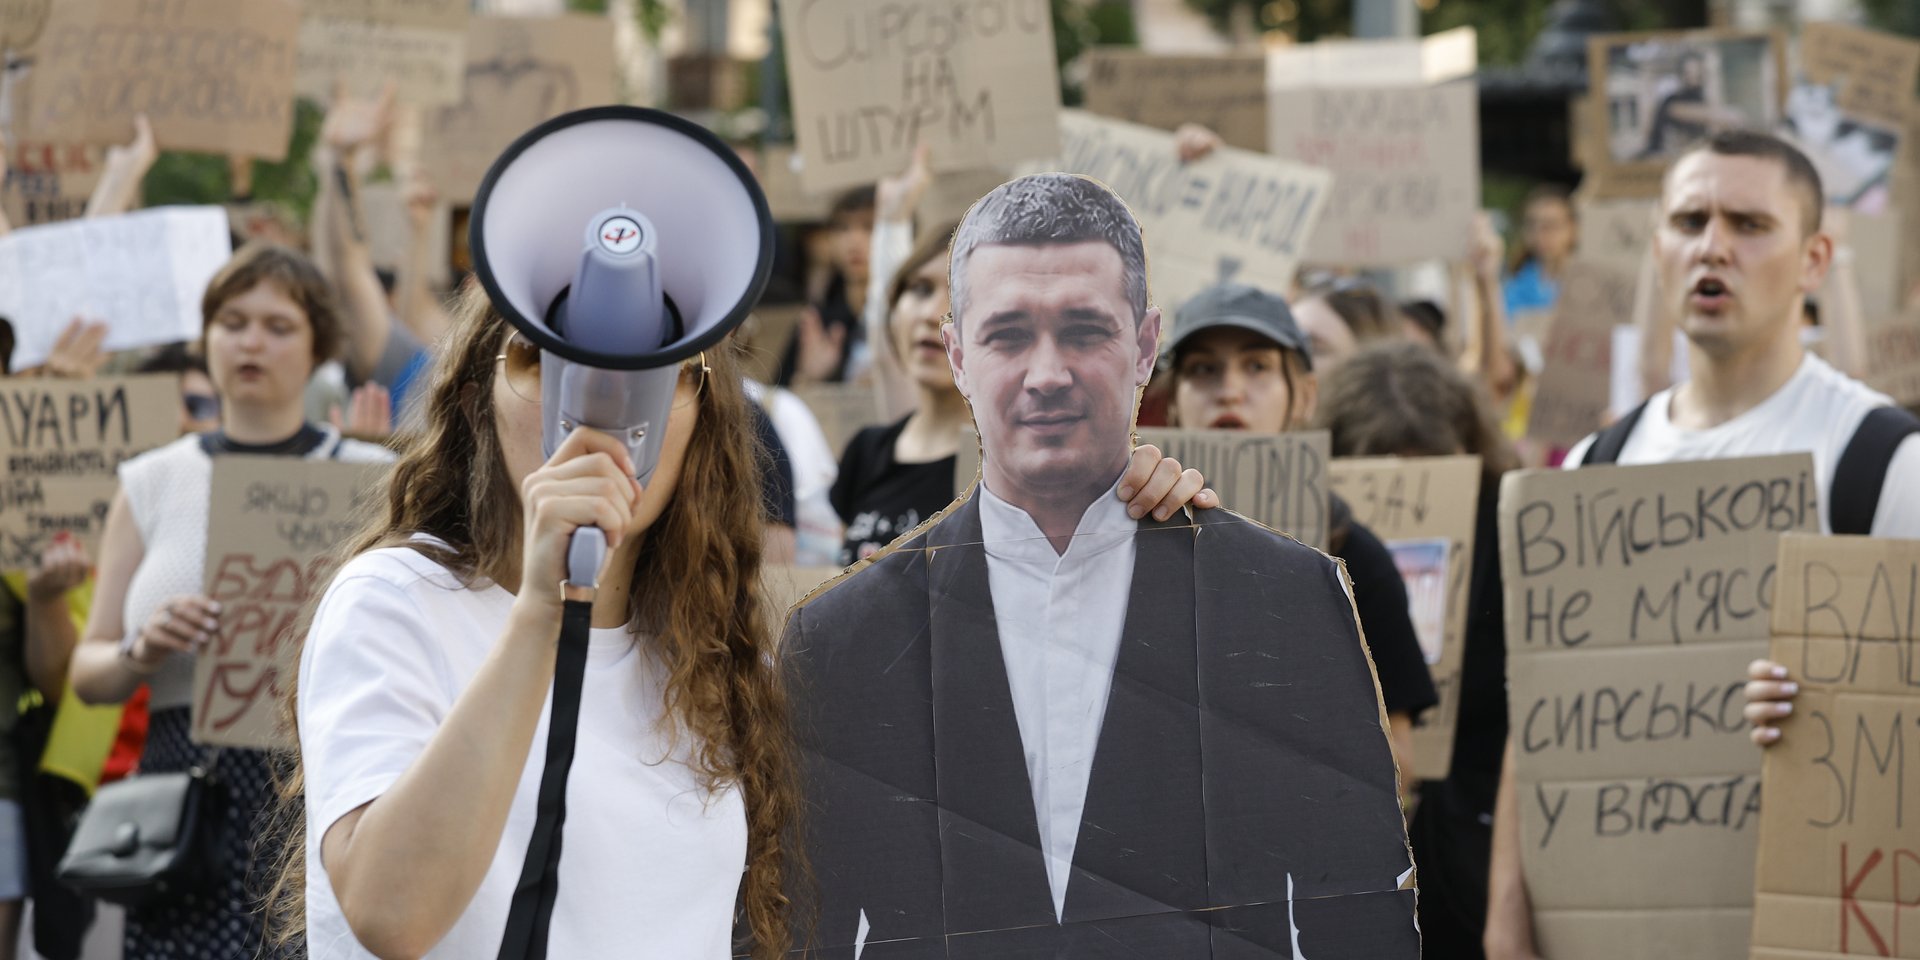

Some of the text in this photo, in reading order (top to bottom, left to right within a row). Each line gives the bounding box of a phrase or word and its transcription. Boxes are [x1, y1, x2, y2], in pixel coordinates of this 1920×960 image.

[901, 54, 959, 103] НА
[815, 86, 998, 163] ШТУРМ
[1808, 711, 1920, 830] ЗМ
